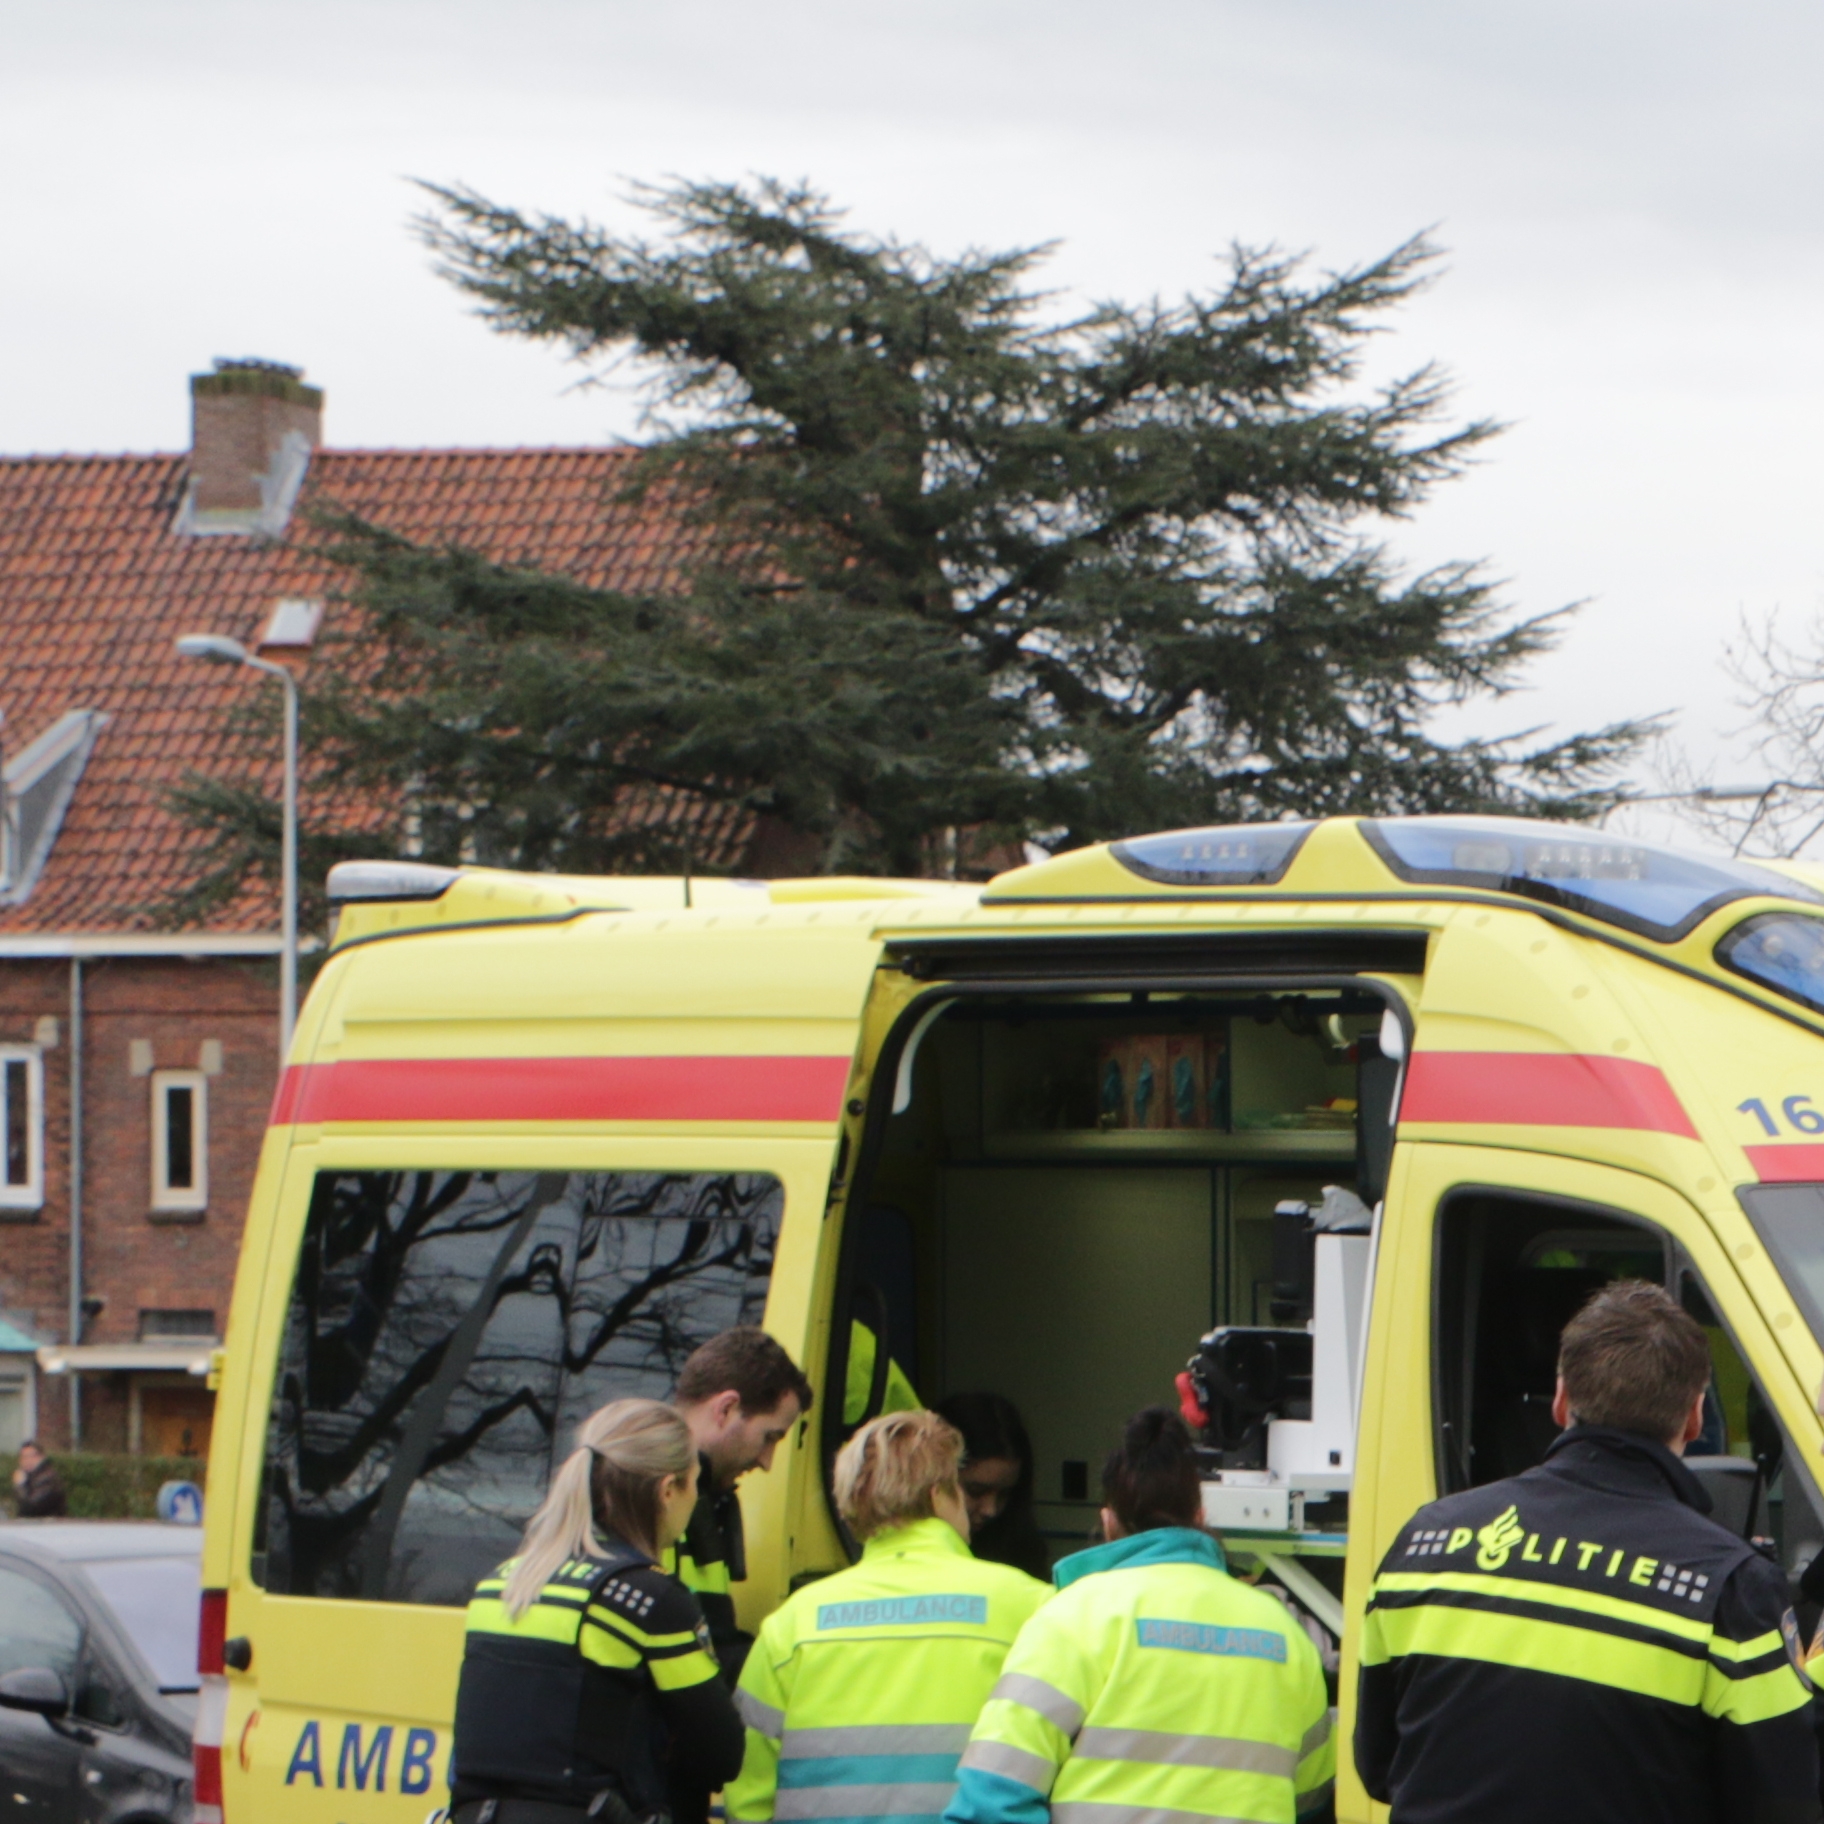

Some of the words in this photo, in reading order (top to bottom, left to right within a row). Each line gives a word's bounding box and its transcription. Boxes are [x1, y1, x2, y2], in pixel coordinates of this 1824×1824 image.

[1445, 1524, 1658, 1587] POLITIE
[823, 1597, 983, 1627] AMBULANCE
[1143, 1622, 1286, 1659] AMBULANCE
[284, 1719, 457, 1796] AMB
